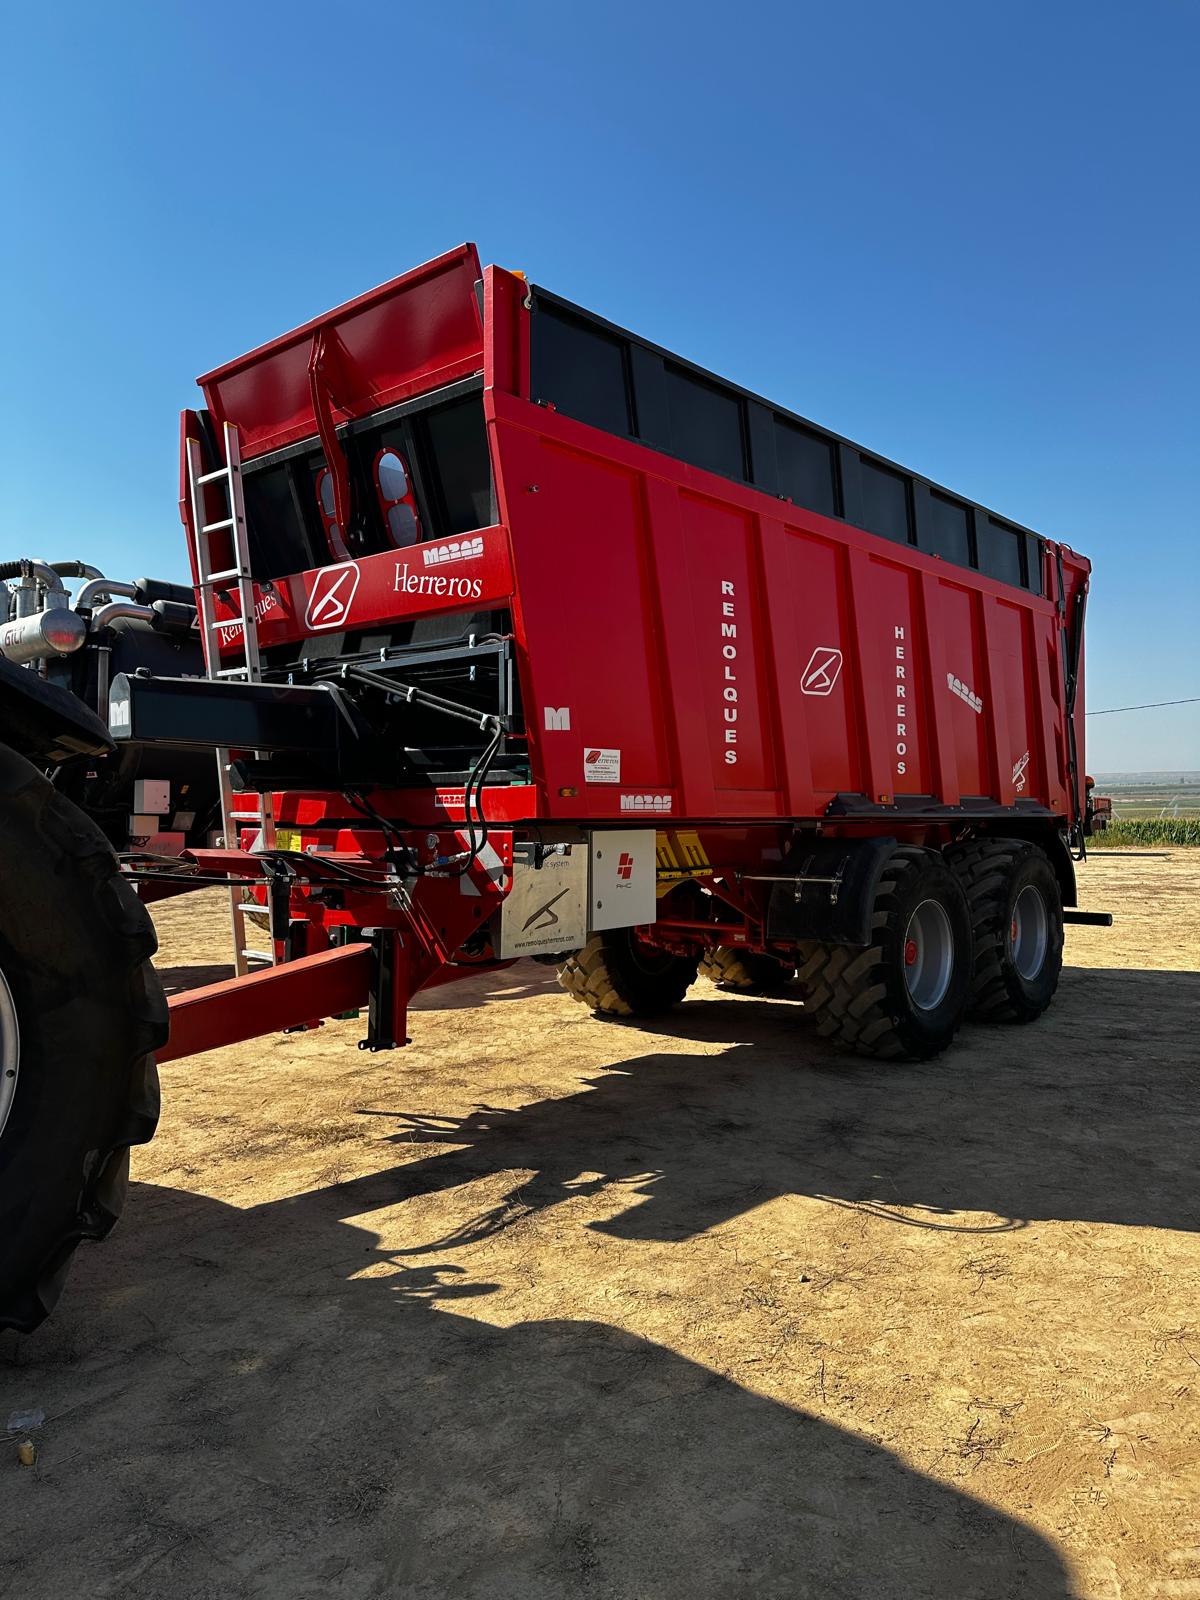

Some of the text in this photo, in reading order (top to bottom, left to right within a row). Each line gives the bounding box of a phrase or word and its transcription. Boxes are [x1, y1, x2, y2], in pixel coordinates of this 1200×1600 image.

[393, 562, 483, 599] Herreros
[721, 580, 738, 764] REMOLQUES
[111, 700, 129, 727] M
[543, 706, 571, 731] M
[894, 625, 907, 775] HERREROS
